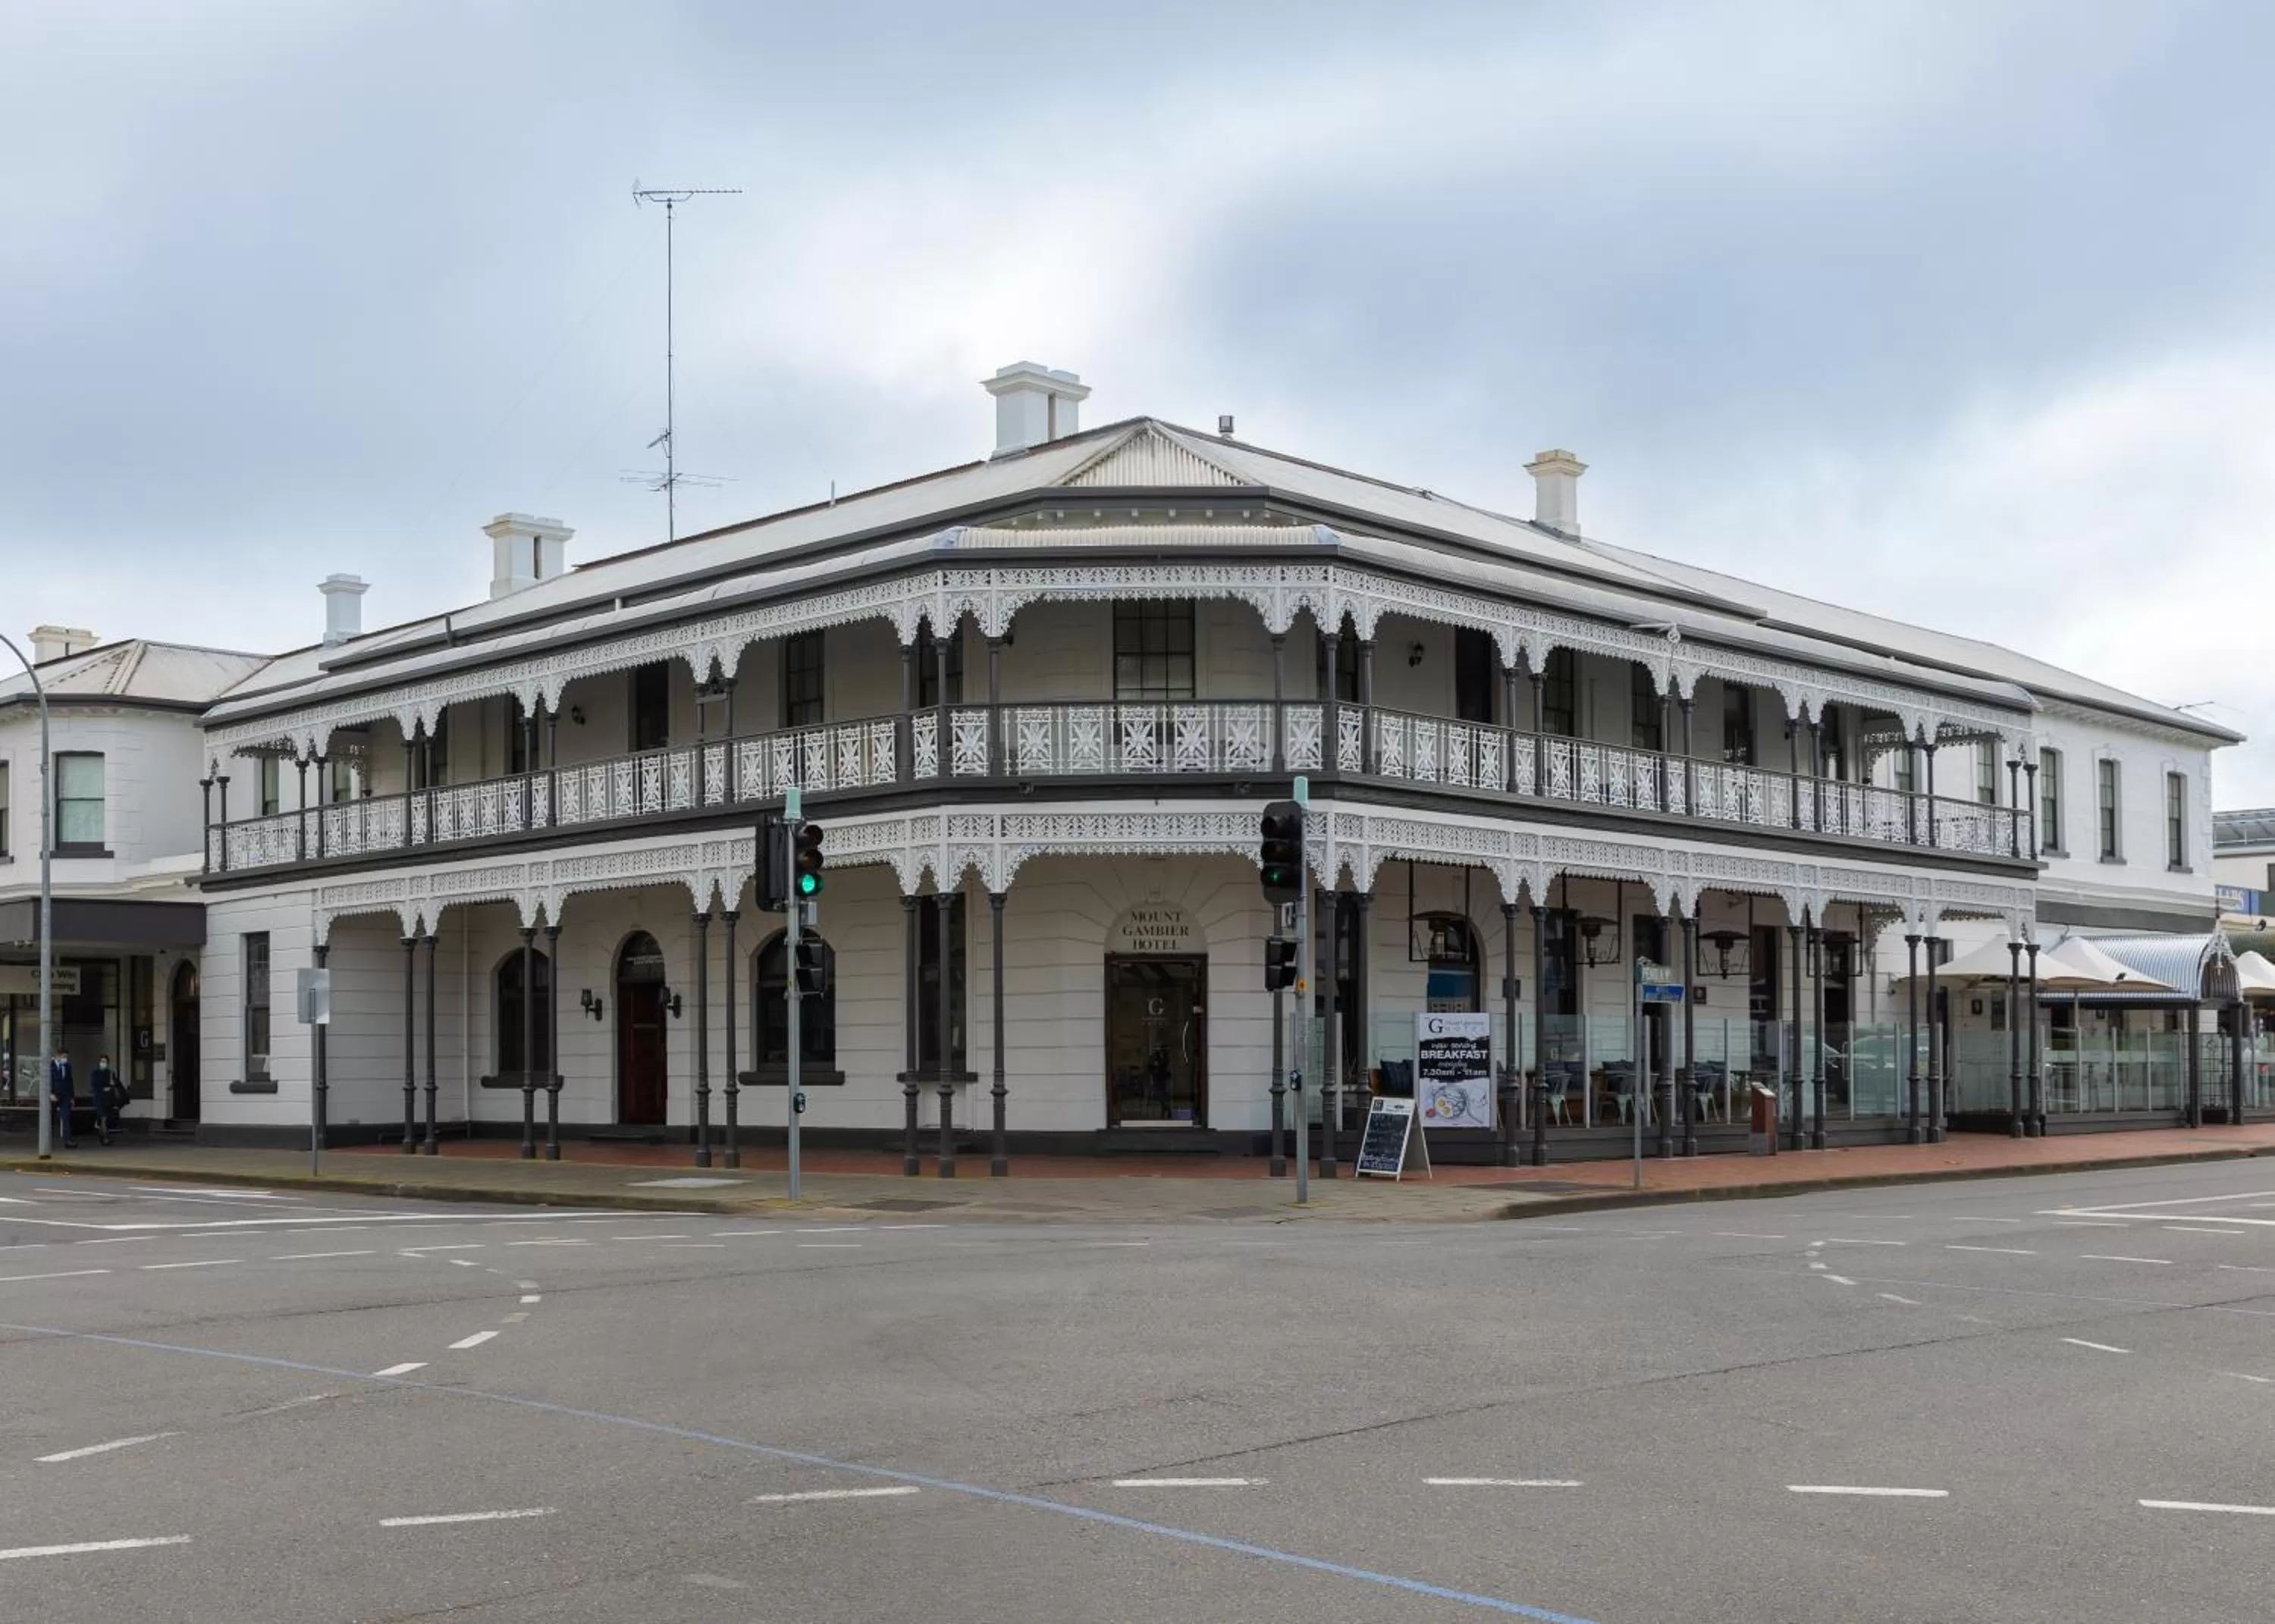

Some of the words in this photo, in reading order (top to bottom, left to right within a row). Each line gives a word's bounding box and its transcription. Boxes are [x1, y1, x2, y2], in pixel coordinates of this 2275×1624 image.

[1131, 911, 1181, 923] MOUNT
[1122, 925, 1189, 936] GAMBIER
[1133, 939, 1181, 950] HOTEL
[1429, 1018, 1444, 1033] G
[1420, 1050, 1488, 1059] BREAKFAST
